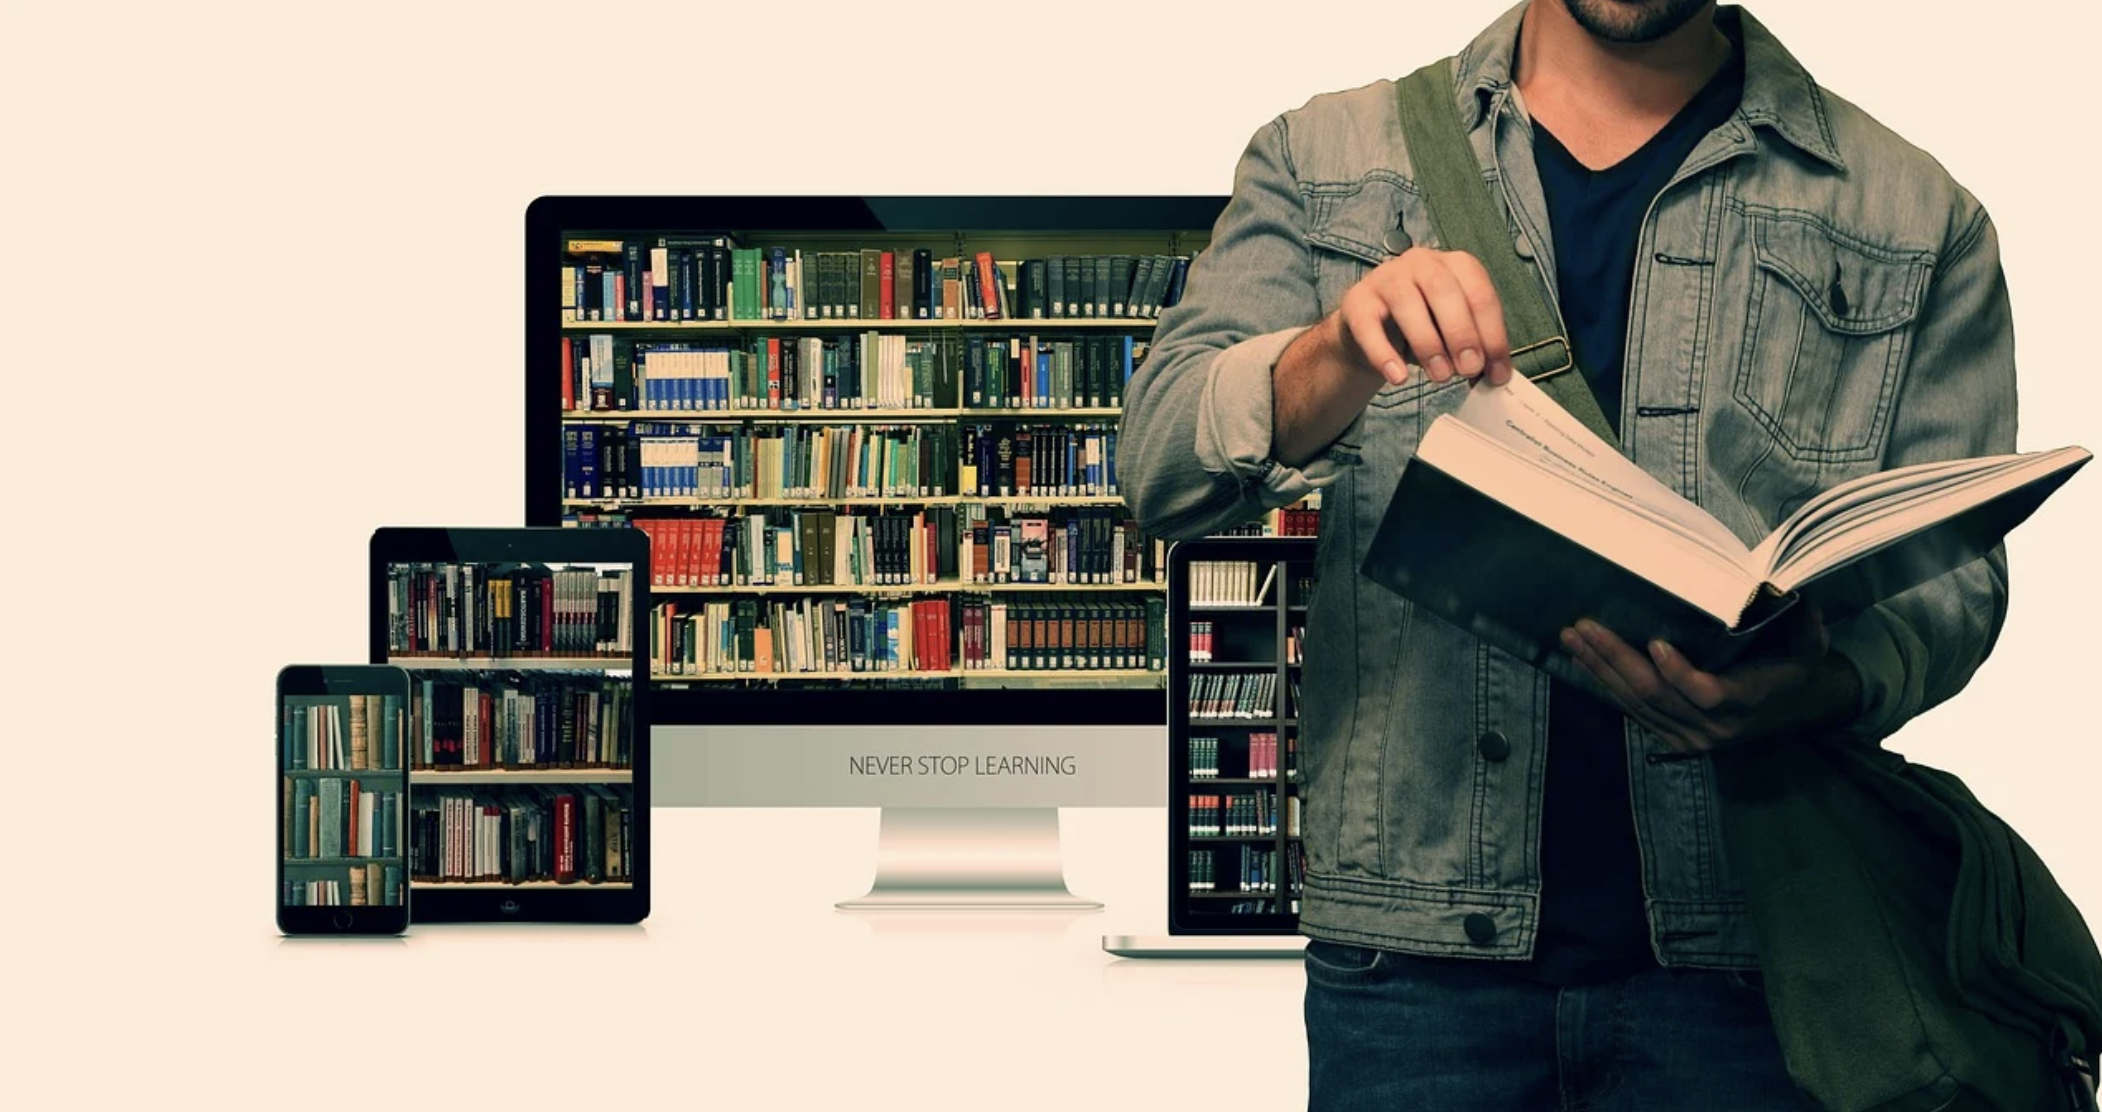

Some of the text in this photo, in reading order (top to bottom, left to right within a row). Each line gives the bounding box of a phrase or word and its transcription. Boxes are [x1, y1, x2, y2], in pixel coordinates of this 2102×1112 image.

[849, 756, 1076, 775] NEVER STOP LEARNING
